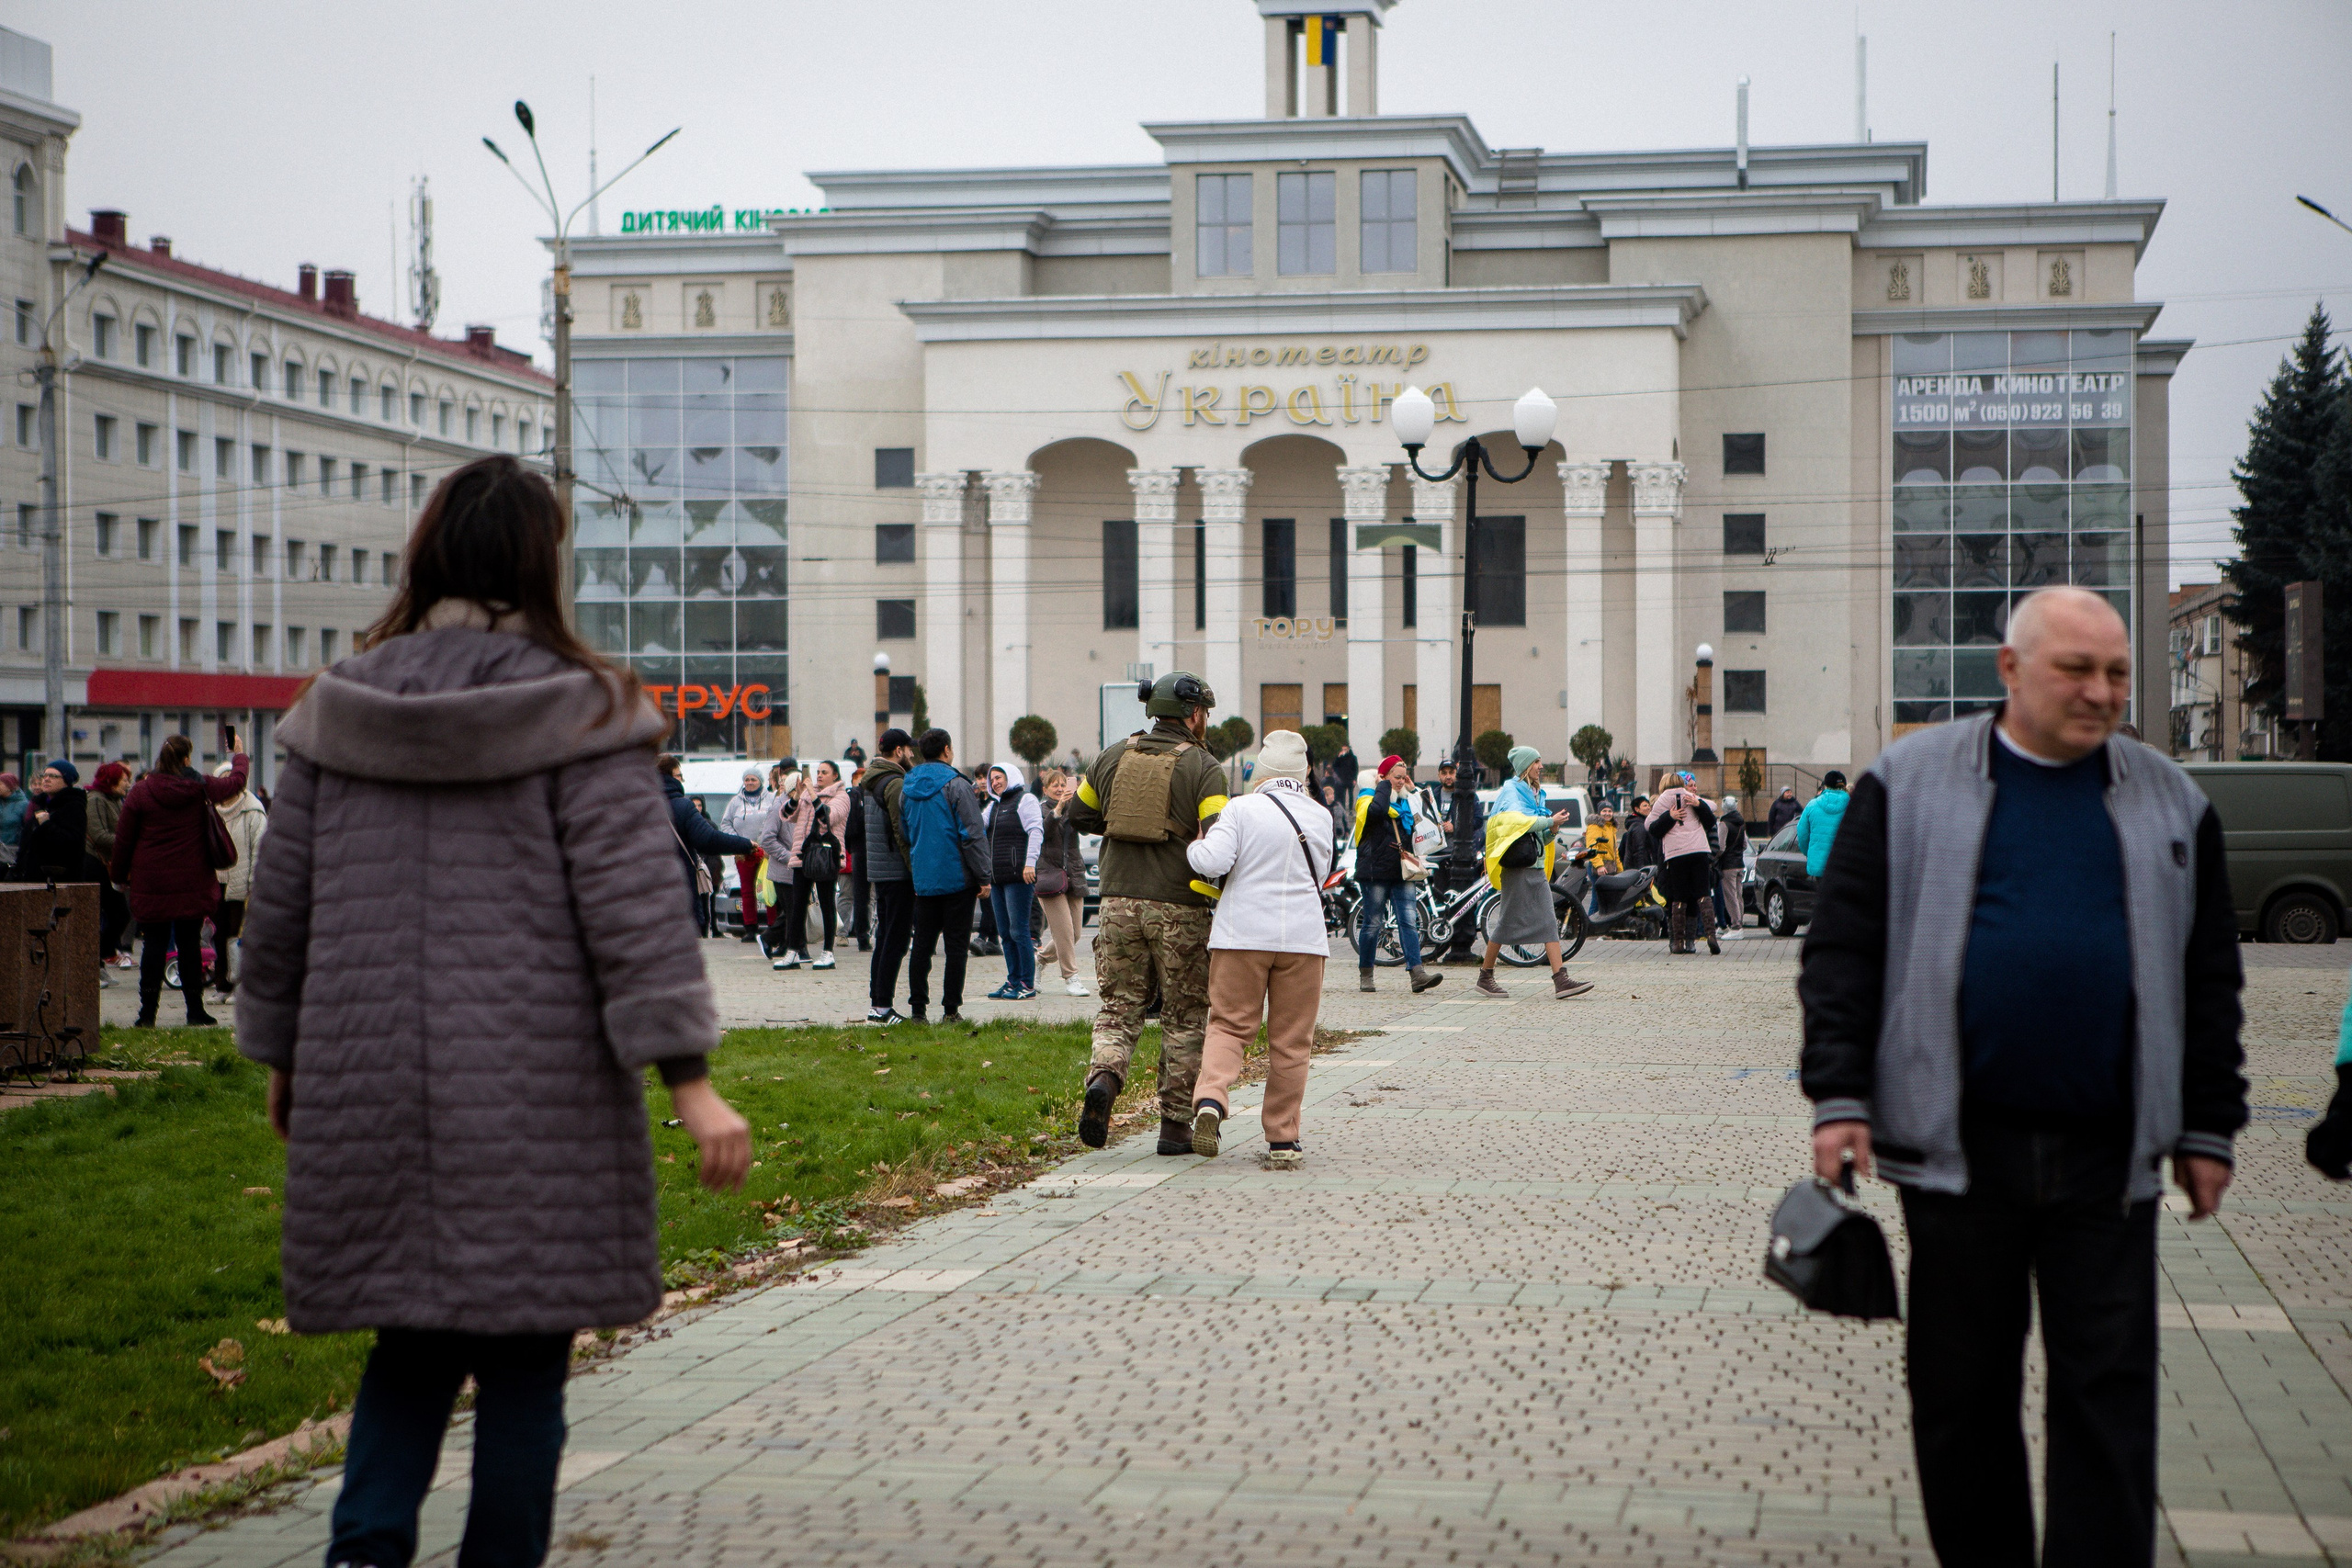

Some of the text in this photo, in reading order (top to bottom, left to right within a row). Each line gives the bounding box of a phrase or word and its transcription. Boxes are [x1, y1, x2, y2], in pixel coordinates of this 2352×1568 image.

[621, 205, 724, 233] ДИТЯЧИЙ
[1188, 341, 1430, 370] кінотеатр
[1897, 374, 2125, 397] АРЕНДА КИНОТЕАТР
[1117, 369, 1468, 431] Україна
[1899, 403, 1949, 423] 1500
[2071, 402, 2093, 420] 56
